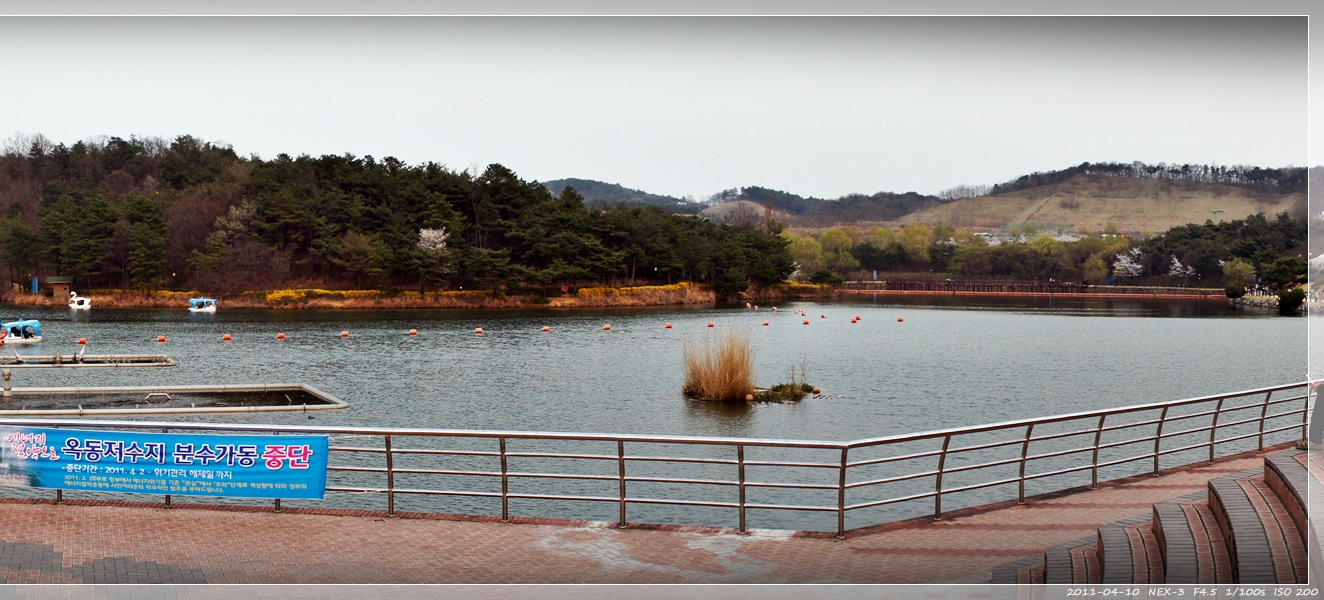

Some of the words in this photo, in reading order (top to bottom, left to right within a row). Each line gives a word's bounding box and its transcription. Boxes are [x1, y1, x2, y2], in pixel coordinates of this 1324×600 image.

[7, 432, 47, 445] 에너지
[11, 443, 60, 460] 절약으로
[61, 437, 166, 464] 옥동저수지
[172, 443, 259, 467] 분수가동
[262, 445, 313, 470] 중단
[66, 464, 98, 474] 중단기간
[105, 466, 127, 475] 2011.
[154, 468, 187, 477] 위기관리
[189, 470, 214, 479] 해제일
[216, 470, 232, 480] 까지
